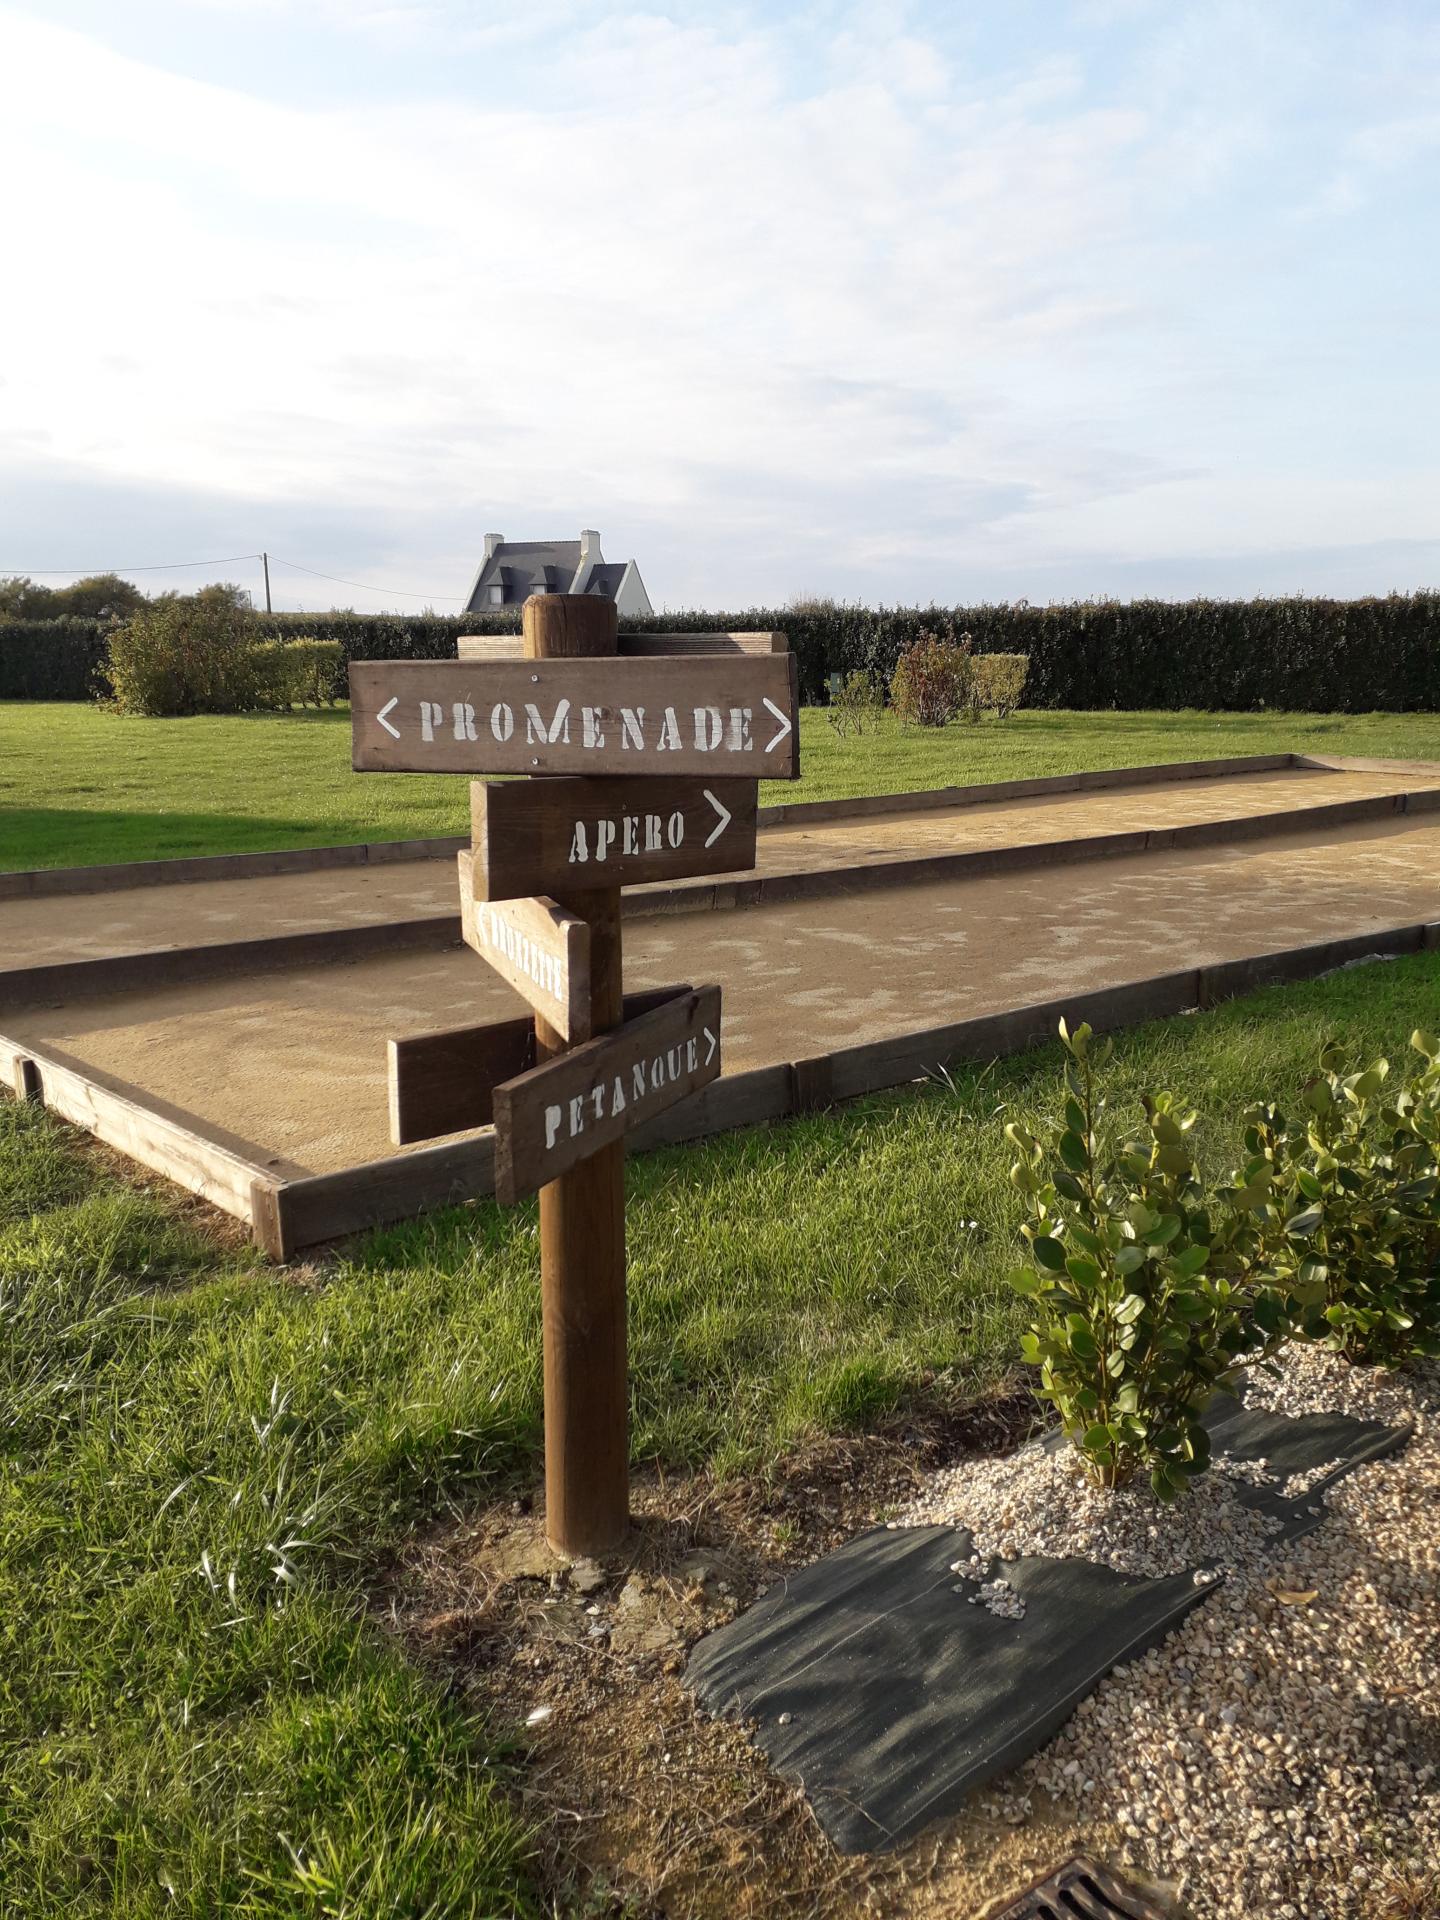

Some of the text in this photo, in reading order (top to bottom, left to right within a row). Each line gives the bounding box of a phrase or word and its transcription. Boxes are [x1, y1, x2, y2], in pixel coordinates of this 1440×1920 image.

[419, 698, 753, 752] PROMENADE
[568, 811, 684, 863] APERO
[544, 1036, 699, 1150] PETANQUE
